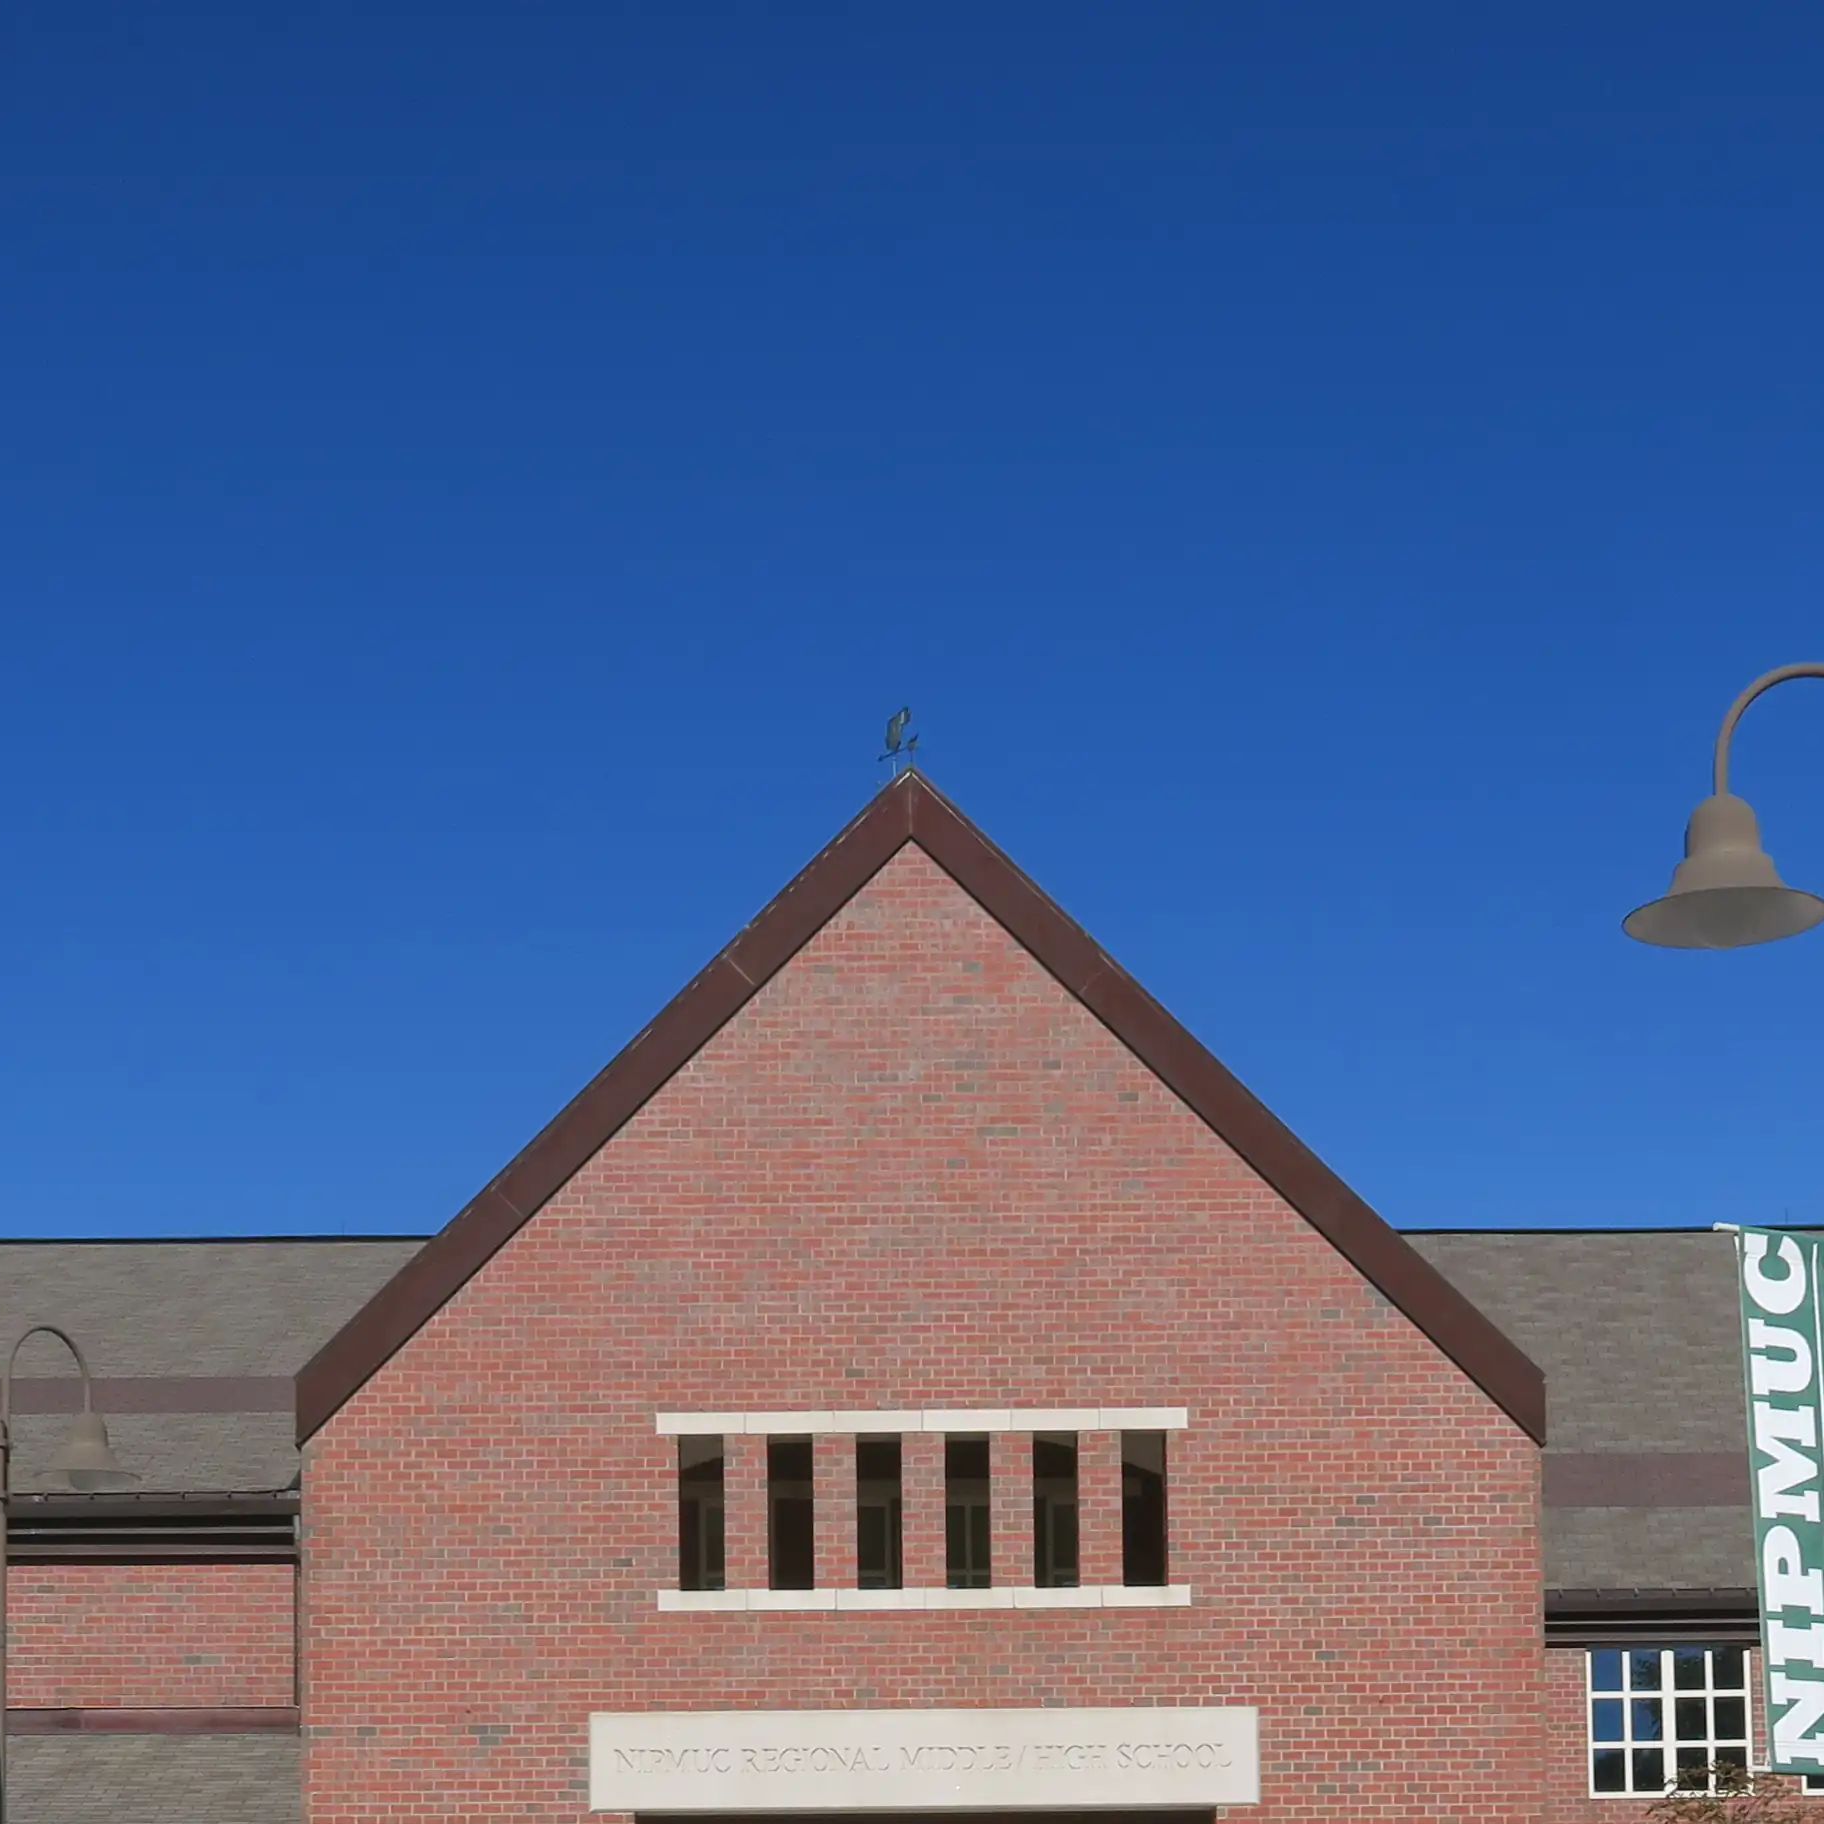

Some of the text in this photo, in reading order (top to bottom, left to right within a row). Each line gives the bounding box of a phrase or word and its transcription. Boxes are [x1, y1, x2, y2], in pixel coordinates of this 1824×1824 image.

[612, 1747, 732, 1773] NIPMUC
[739, 1747, 891, 1773] REGIONAL
[1033, 1744, 1108, 1770] HIGH
[1116, 1743, 1233, 1769] SCHOOL
